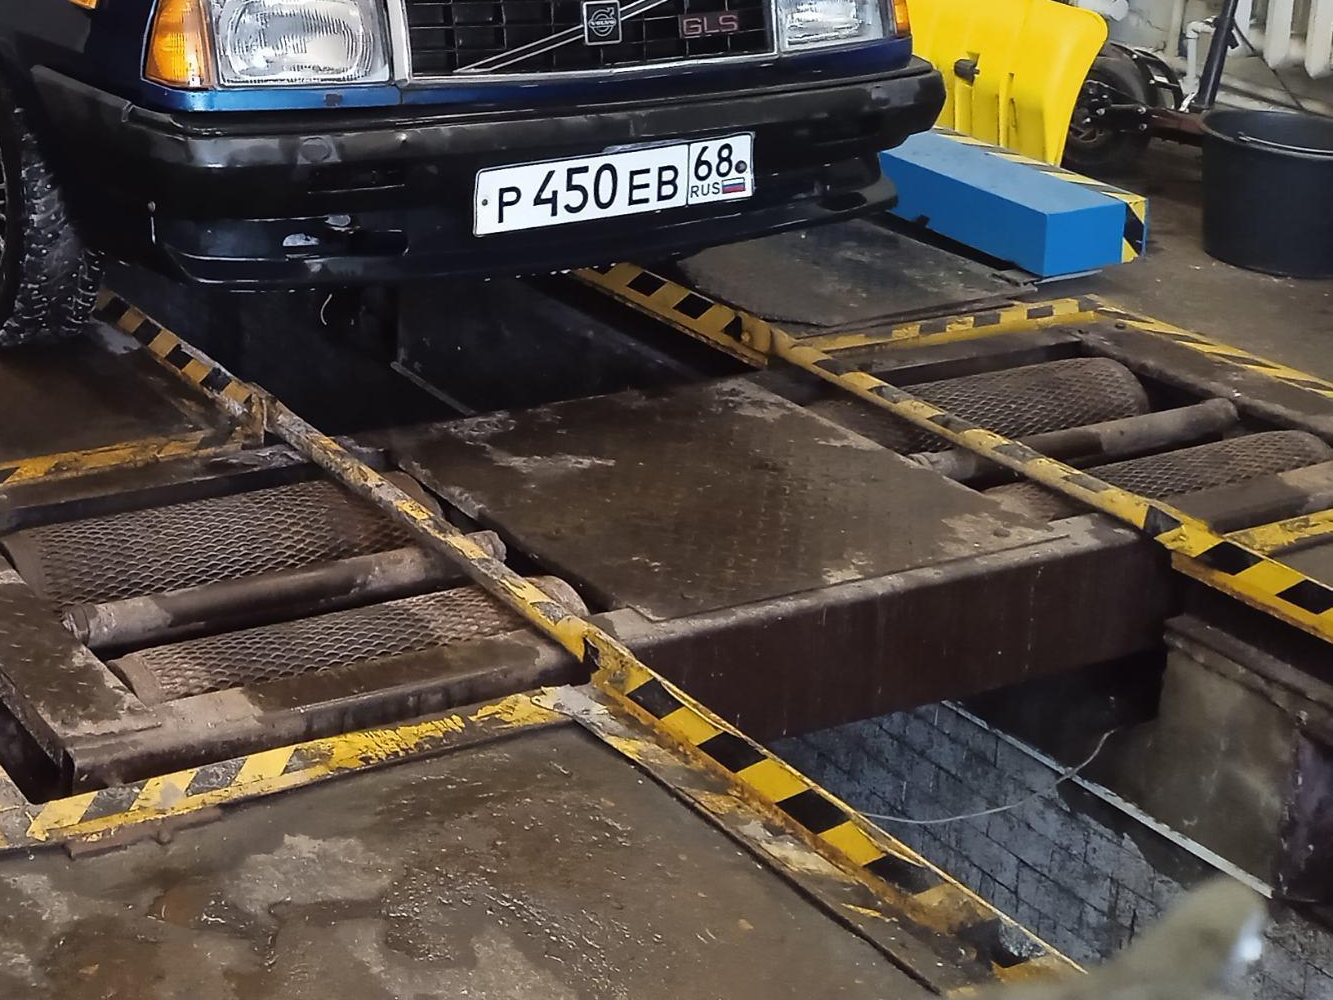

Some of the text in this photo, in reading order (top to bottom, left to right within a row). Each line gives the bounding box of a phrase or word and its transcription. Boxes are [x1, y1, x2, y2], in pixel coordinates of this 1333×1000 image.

[682, 14, 738, 36] GLS
[497, 143, 734, 224] Р450ЕВ 68
[689, 181, 721, 198] RUS
